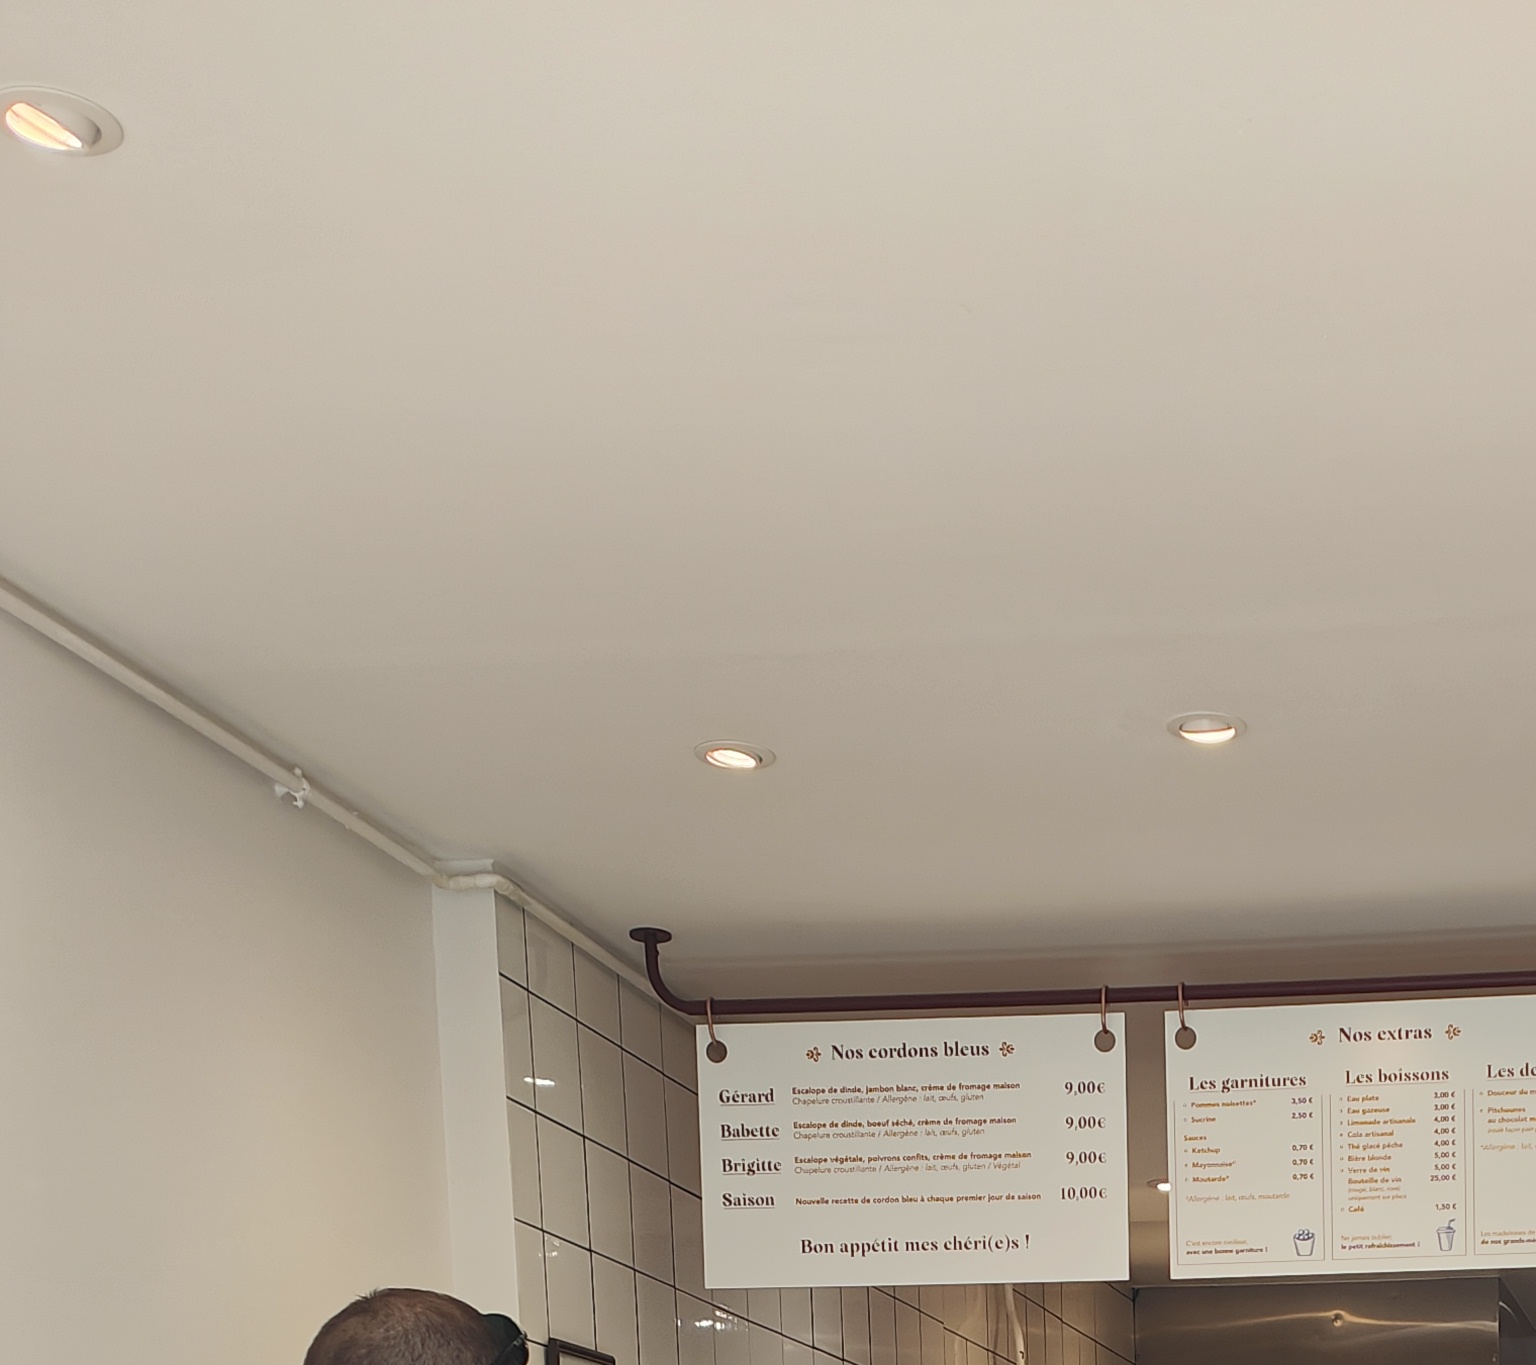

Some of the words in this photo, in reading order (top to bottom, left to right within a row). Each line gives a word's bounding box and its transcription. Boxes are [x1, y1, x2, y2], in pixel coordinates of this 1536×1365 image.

[1339, 1027, 1372, 1042] Nos
[1378, 1027, 1432, 1041] extras
[831, 1044, 864, 1060] Nos
[868, 1042, 938, 1059] cordons
[944, 1041, 990, 1057] bleus
[1346, 1070, 1373, 1084] Les
[1378, 1067, 1449, 1082] boissons
[1487, 1064, 1514, 1078] Les
[1065, 1081, 1105, 1096] 9,00€
[1190, 1076, 1216, 1090] Les
[1221, 1073, 1306, 1092] garnitures
[719, 1088, 774, 1104] Gérard
[721, 1123, 780, 1138] Babette
[1066, 1116, 1104, 1131] 9,00€
[1066, 1151, 1106, 1166] 9,00€
[722, 1157, 782, 1177] Brigitte
[722, 1192, 774, 1207] Saison
[1062, 1187, 1107, 1201] 10,00€
[801, 1239, 834, 1254] Bon
[840, 1238, 899, 1258] appétit
[905, 1241, 938, 1252] mes
[944, 1235, 1019, 1253] chéri(e)s
